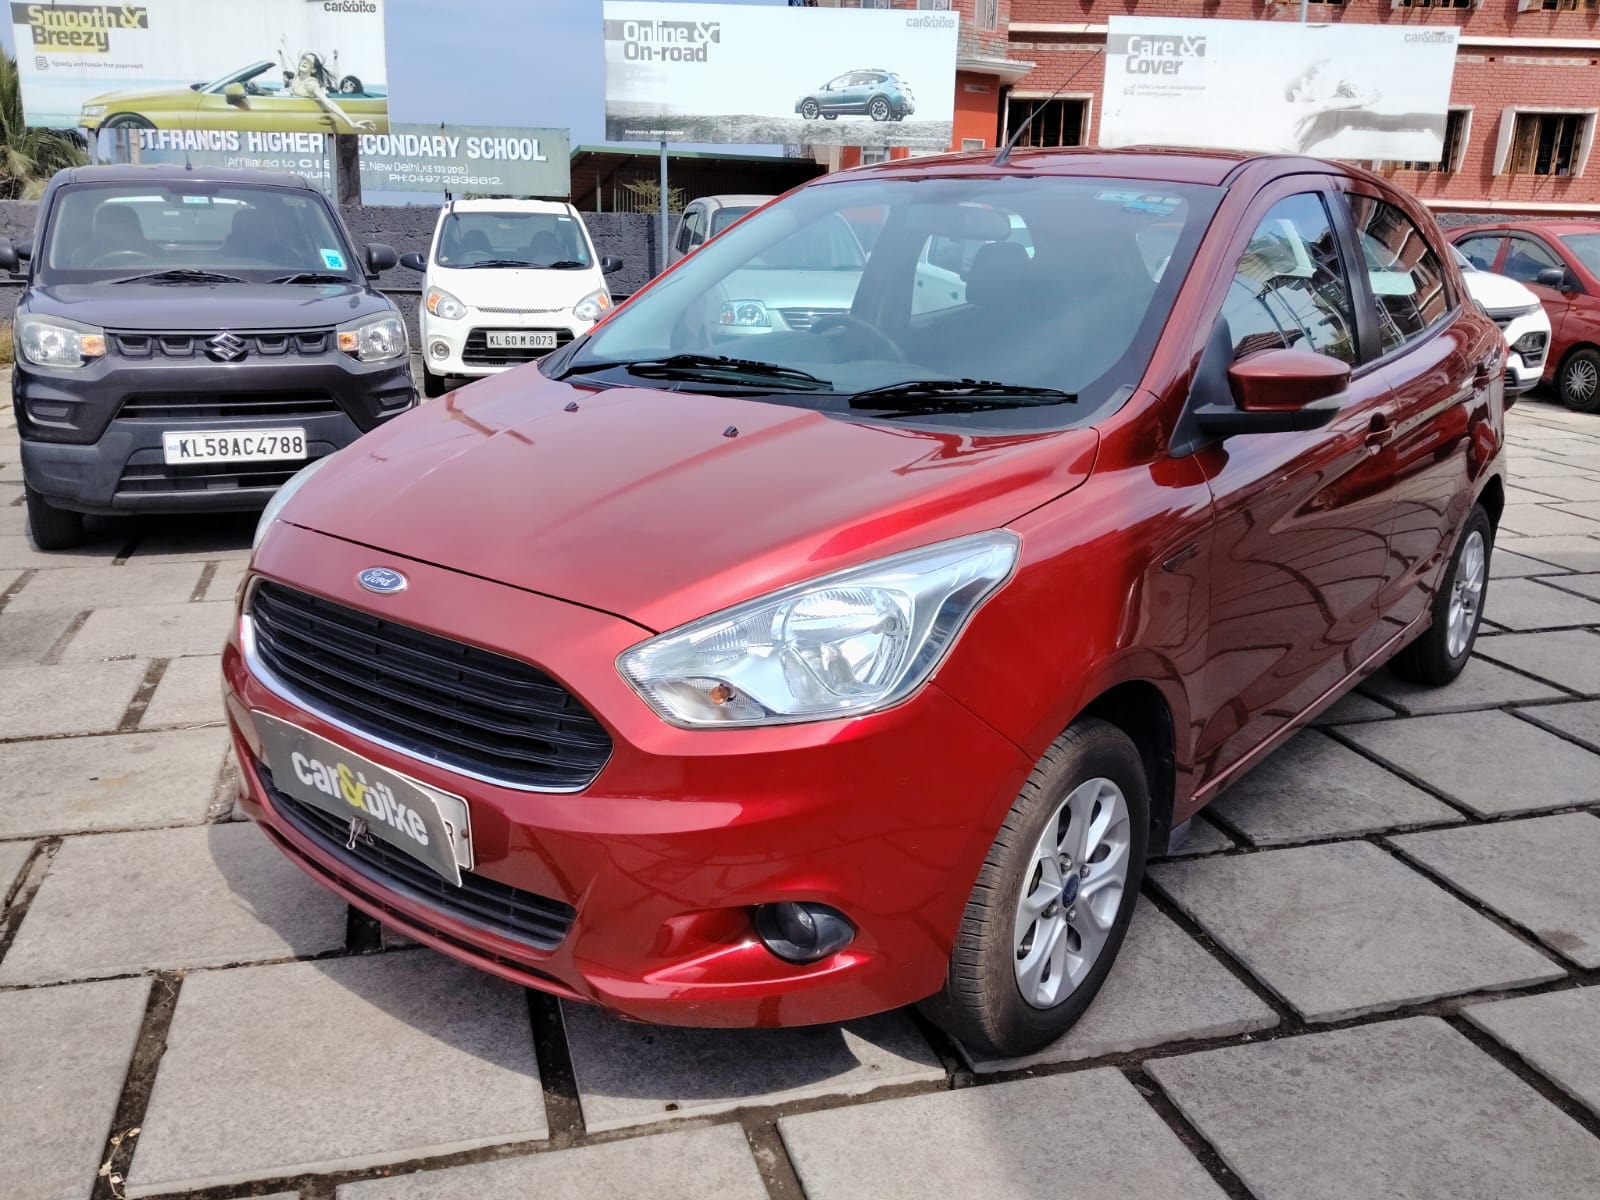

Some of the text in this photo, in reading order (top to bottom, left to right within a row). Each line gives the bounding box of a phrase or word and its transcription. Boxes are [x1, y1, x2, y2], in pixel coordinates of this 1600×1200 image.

[27, 3, 148, 28] Smooth &
[323, 0, 377, 13] car&bike
[623, 20, 720, 44] Online &
[905, 15, 955, 28] car&bike
[31, 25, 110, 52] Breezy
[1127, 34, 1206, 57] Care &
[624, 40, 708, 62] On-road
[1126, 54, 1184, 75] Cover
[248, 131, 324, 153] HIGHER
[358, 134, 460, 158] CONDARY
[467, 137, 547, 161] SCHOOL
[489, 335, 502, 346] KL
[505, 335, 517, 346] 60
[529, 335, 553, 346] 8073
[179, 436, 303, 457] KL58AC4788
[363, 569, 397, 587] Ford
[291, 752, 429, 846] car&bike
